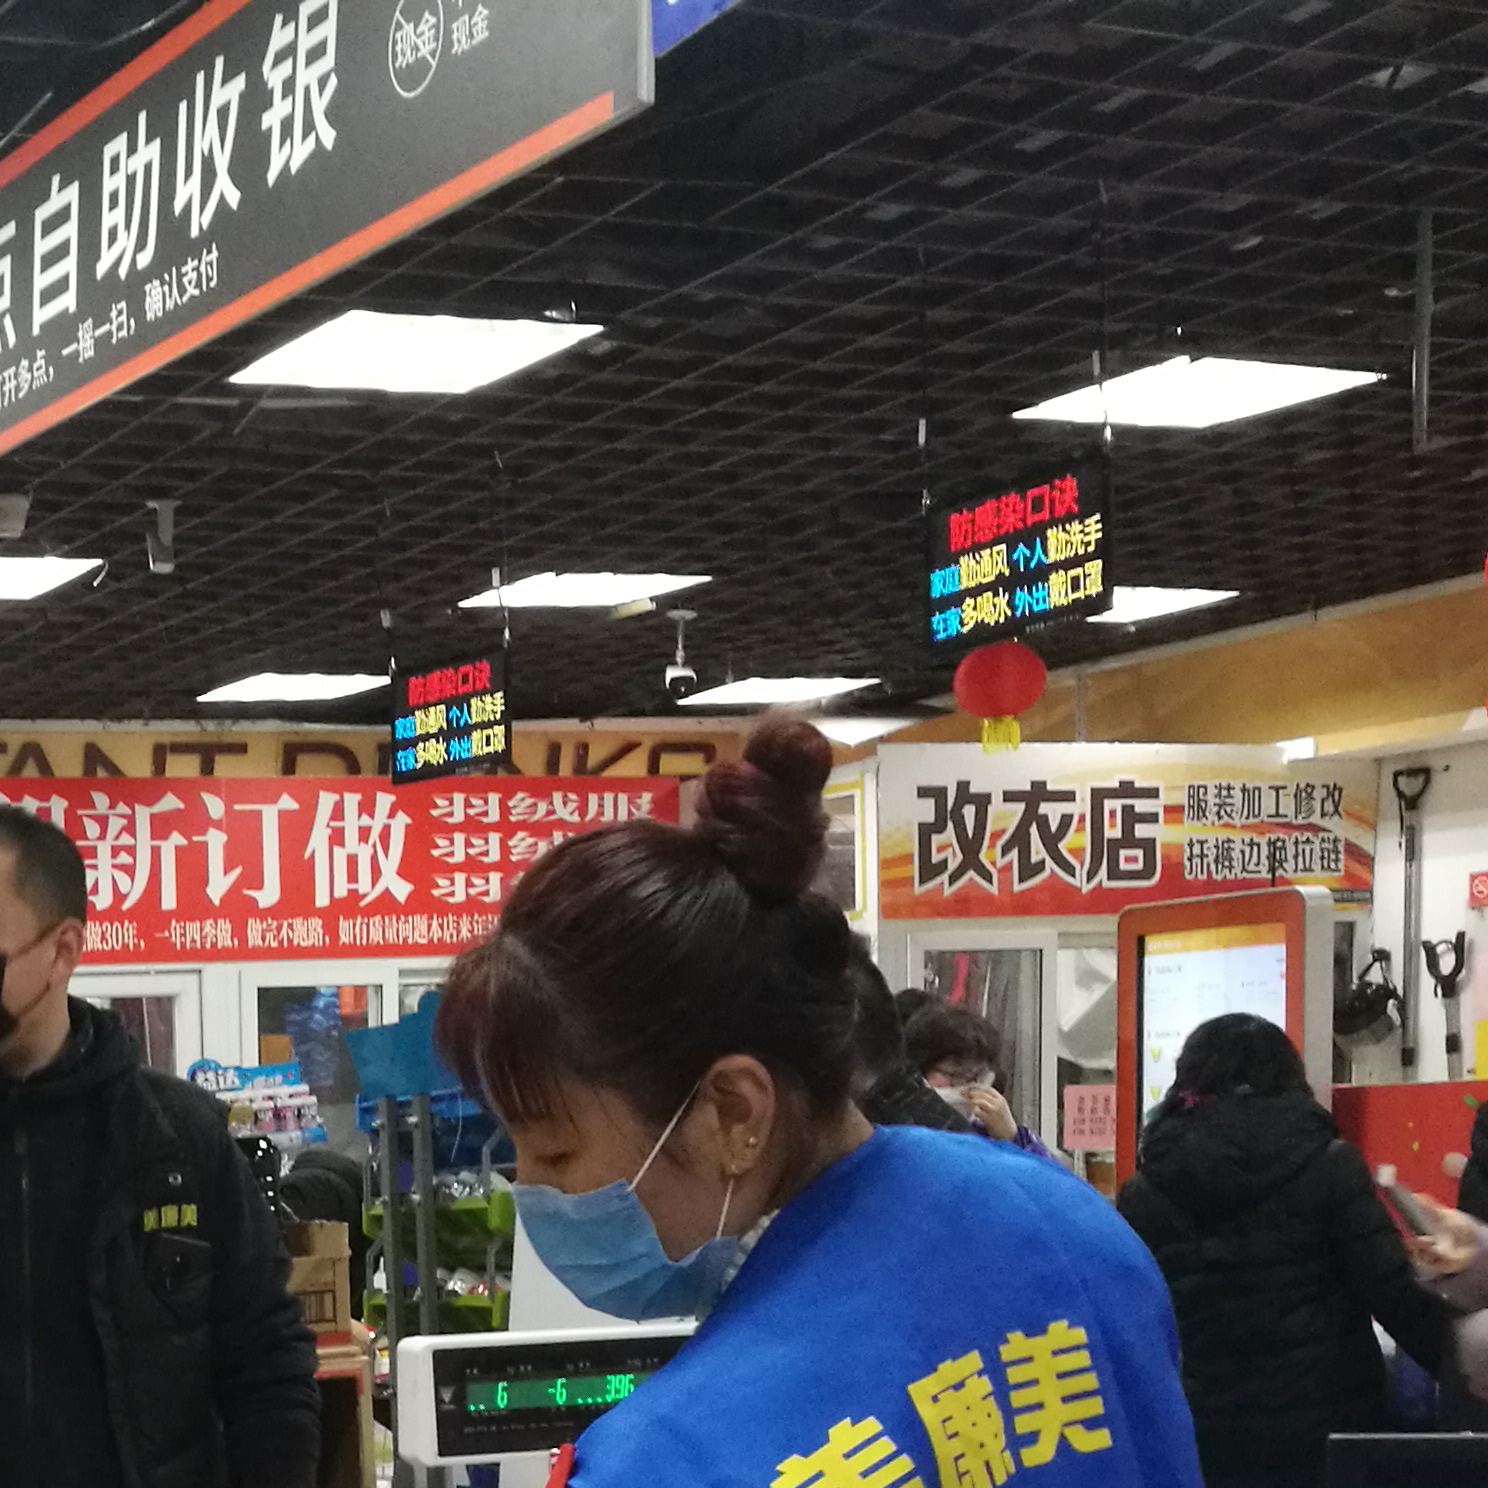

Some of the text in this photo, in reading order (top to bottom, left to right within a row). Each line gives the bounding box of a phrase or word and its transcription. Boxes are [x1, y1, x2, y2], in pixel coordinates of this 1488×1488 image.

[451, 4, 490, 55] 现金
[947, 473, 1079, 553] 防感染口诀
[1013, 558, 1104, 618] 外出戴口罩
[429, 791, 656, 825] 羽绒服
[1186, 782, 1344, 821] 服装加工修改
[915, 778, 1161, 889] 改衣店
